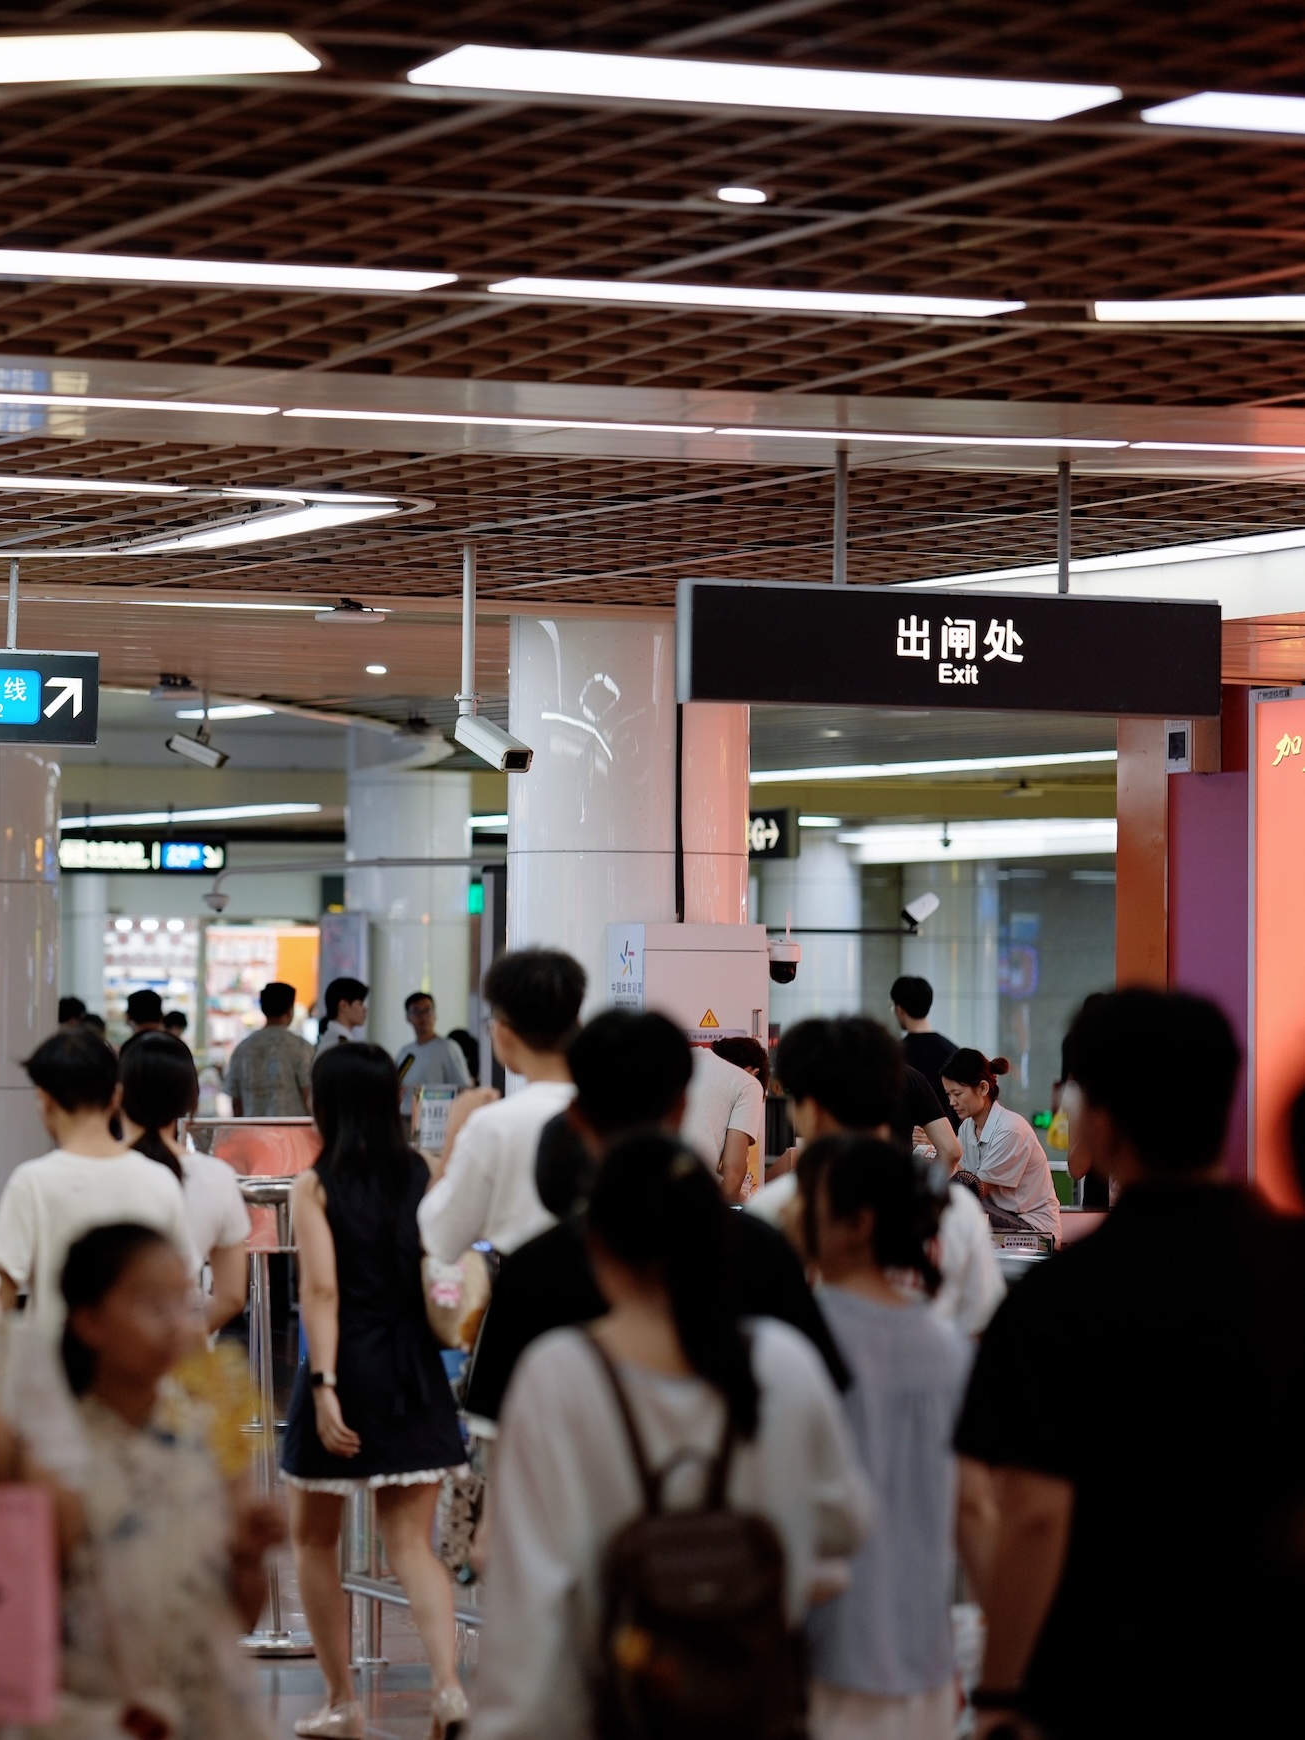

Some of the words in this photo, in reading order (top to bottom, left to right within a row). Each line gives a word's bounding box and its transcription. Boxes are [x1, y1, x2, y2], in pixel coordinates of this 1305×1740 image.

[896, 614, 1024, 663] 出闸处
[938, 663, 979, 685] Exit
